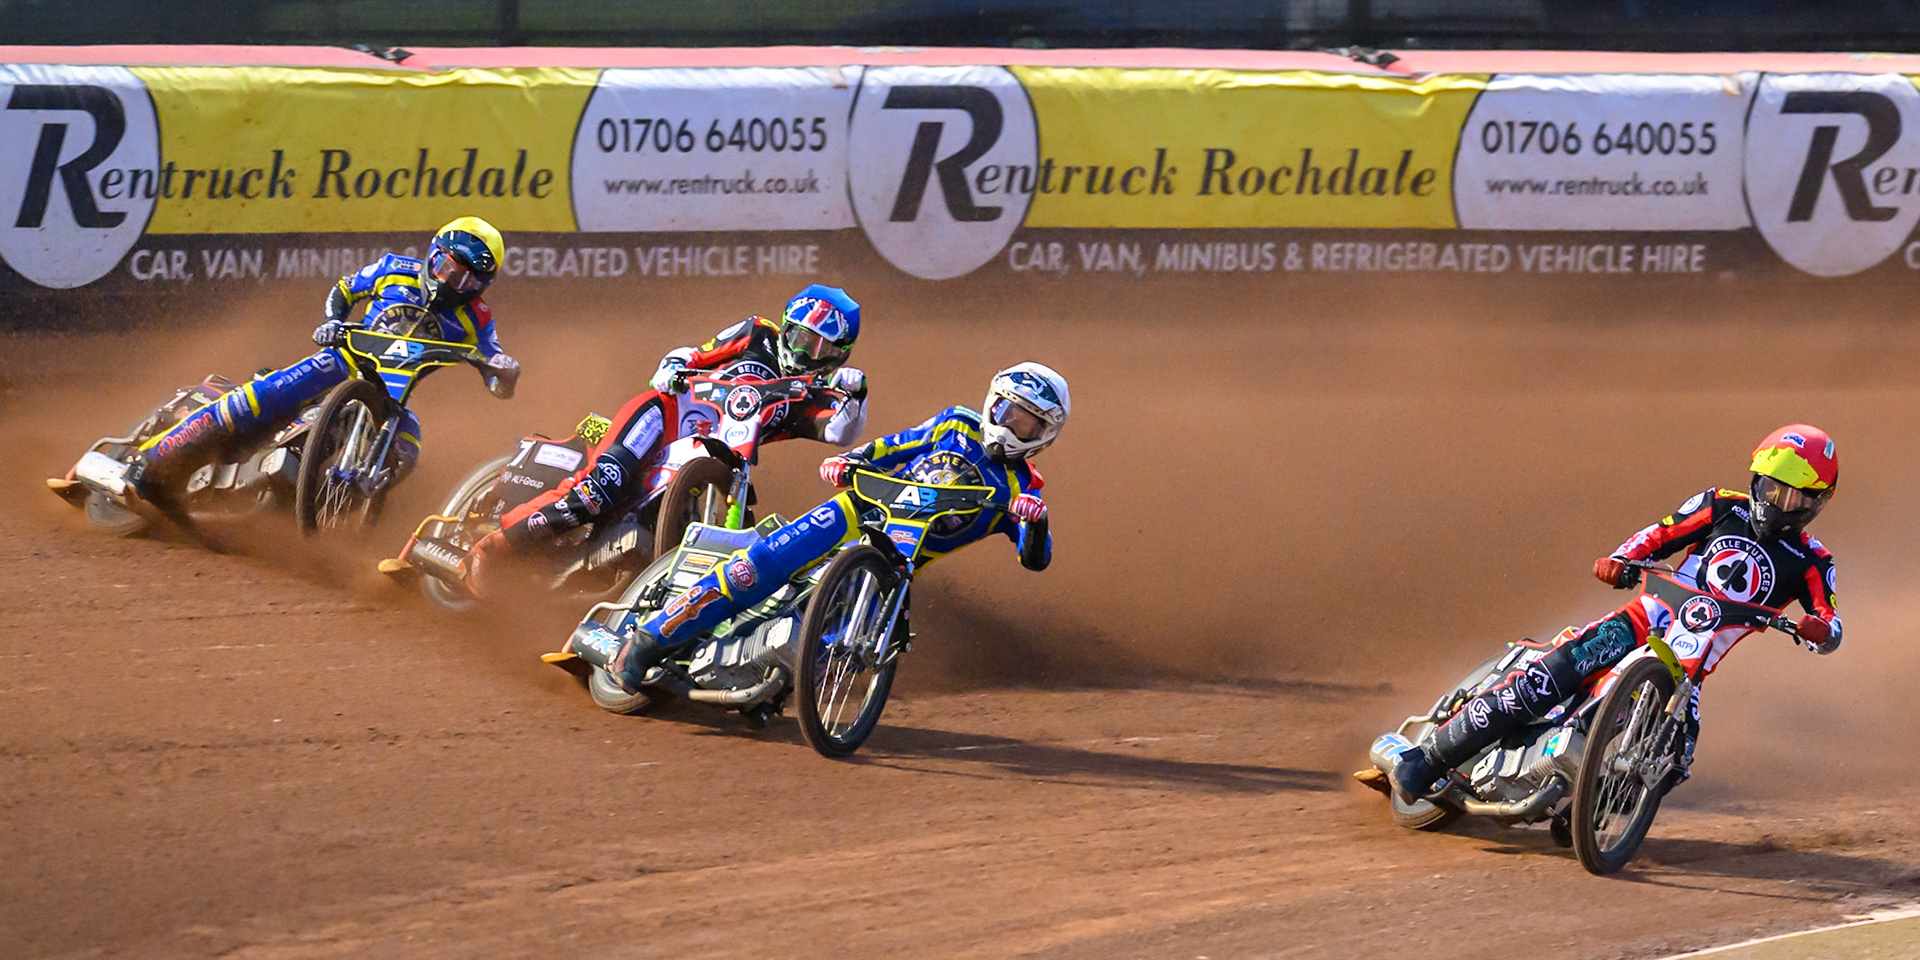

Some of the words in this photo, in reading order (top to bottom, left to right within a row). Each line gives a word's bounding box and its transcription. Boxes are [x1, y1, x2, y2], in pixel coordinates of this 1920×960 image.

[597, 118, 695, 154] 01706
[706, 117, 827, 153] 640055
[1482, 120, 1581, 155] 01706
[1593, 122, 1717, 155] 640055
[6, 84, 296, 229] Rentruck
[313, 149, 553, 200] Rochdale
[882, 85, 1176, 223] Rentruck
[1197, 148, 1436, 196] Rochdale
[604, 169, 820, 196] www.rentruck.co.uk
[1485, 173, 1708, 196] www.rentruck.co.uk
[131, 249, 194, 283] CAR,
[202, 249, 267, 284] VAN,
[504, 247, 628, 277] GERATED
[636, 246, 747, 276] VEHICLE
[757, 246, 819, 275] HIRE
[1009, 242, 1068, 275] CAR,
[1079, 242, 1145, 276] VAN,
[1155, 242, 1277, 271] MINIBUS
[1284, 242, 1302, 271] &
[1311, 242, 1511, 272] REFRIGERATED
[1516, 244, 1634, 273] VEHICLE
[1642, 244, 1706, 273] HIRE
[737, 364, 768, 378] BELLE
[894, 485, 938, 507] AB
[735, 565, 750, 583] STS
[1711, 540, 1741, 554] BELLE
[1745, 543, 1765, 562] VUE
[1761, 566, 1771, 592] ACES
[1675, 640, 1694, 651] ATPI
